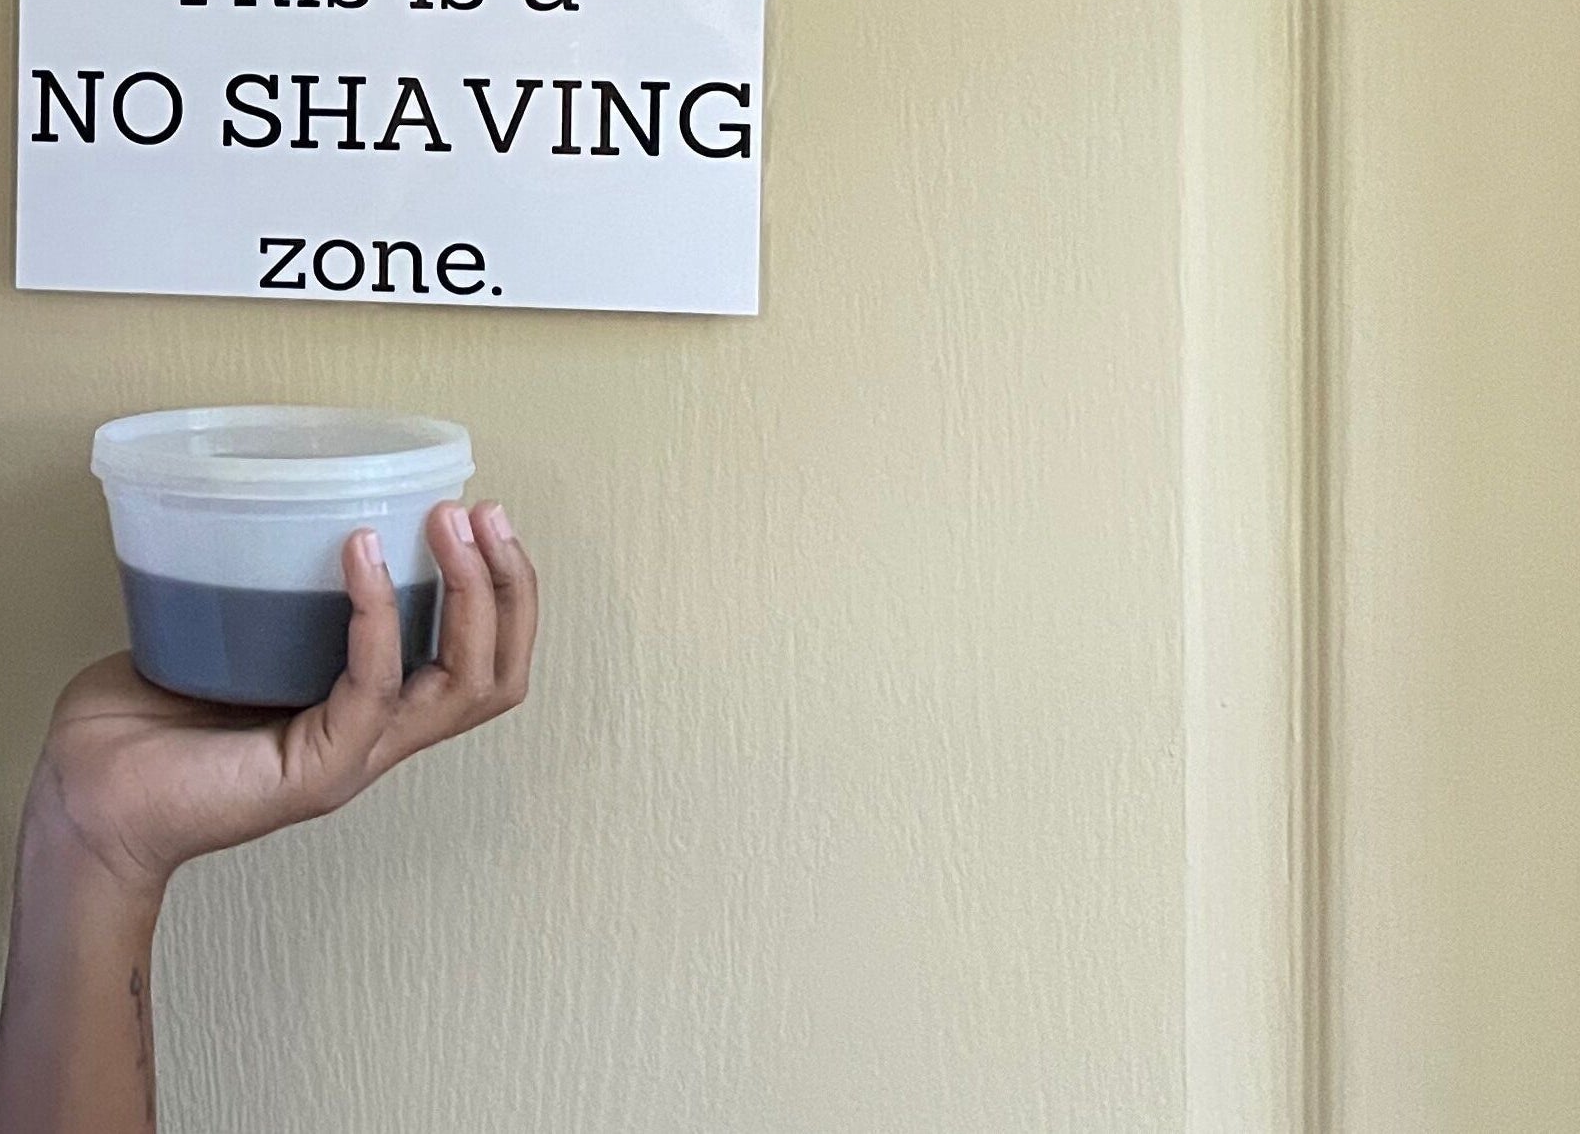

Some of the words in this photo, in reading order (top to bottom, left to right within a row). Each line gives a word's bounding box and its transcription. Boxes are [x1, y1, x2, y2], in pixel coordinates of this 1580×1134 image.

[31, 69, 183, 146] NO
[222, 73, 751, 159] SHAVING
[259, 237, 503, 296] zone.
